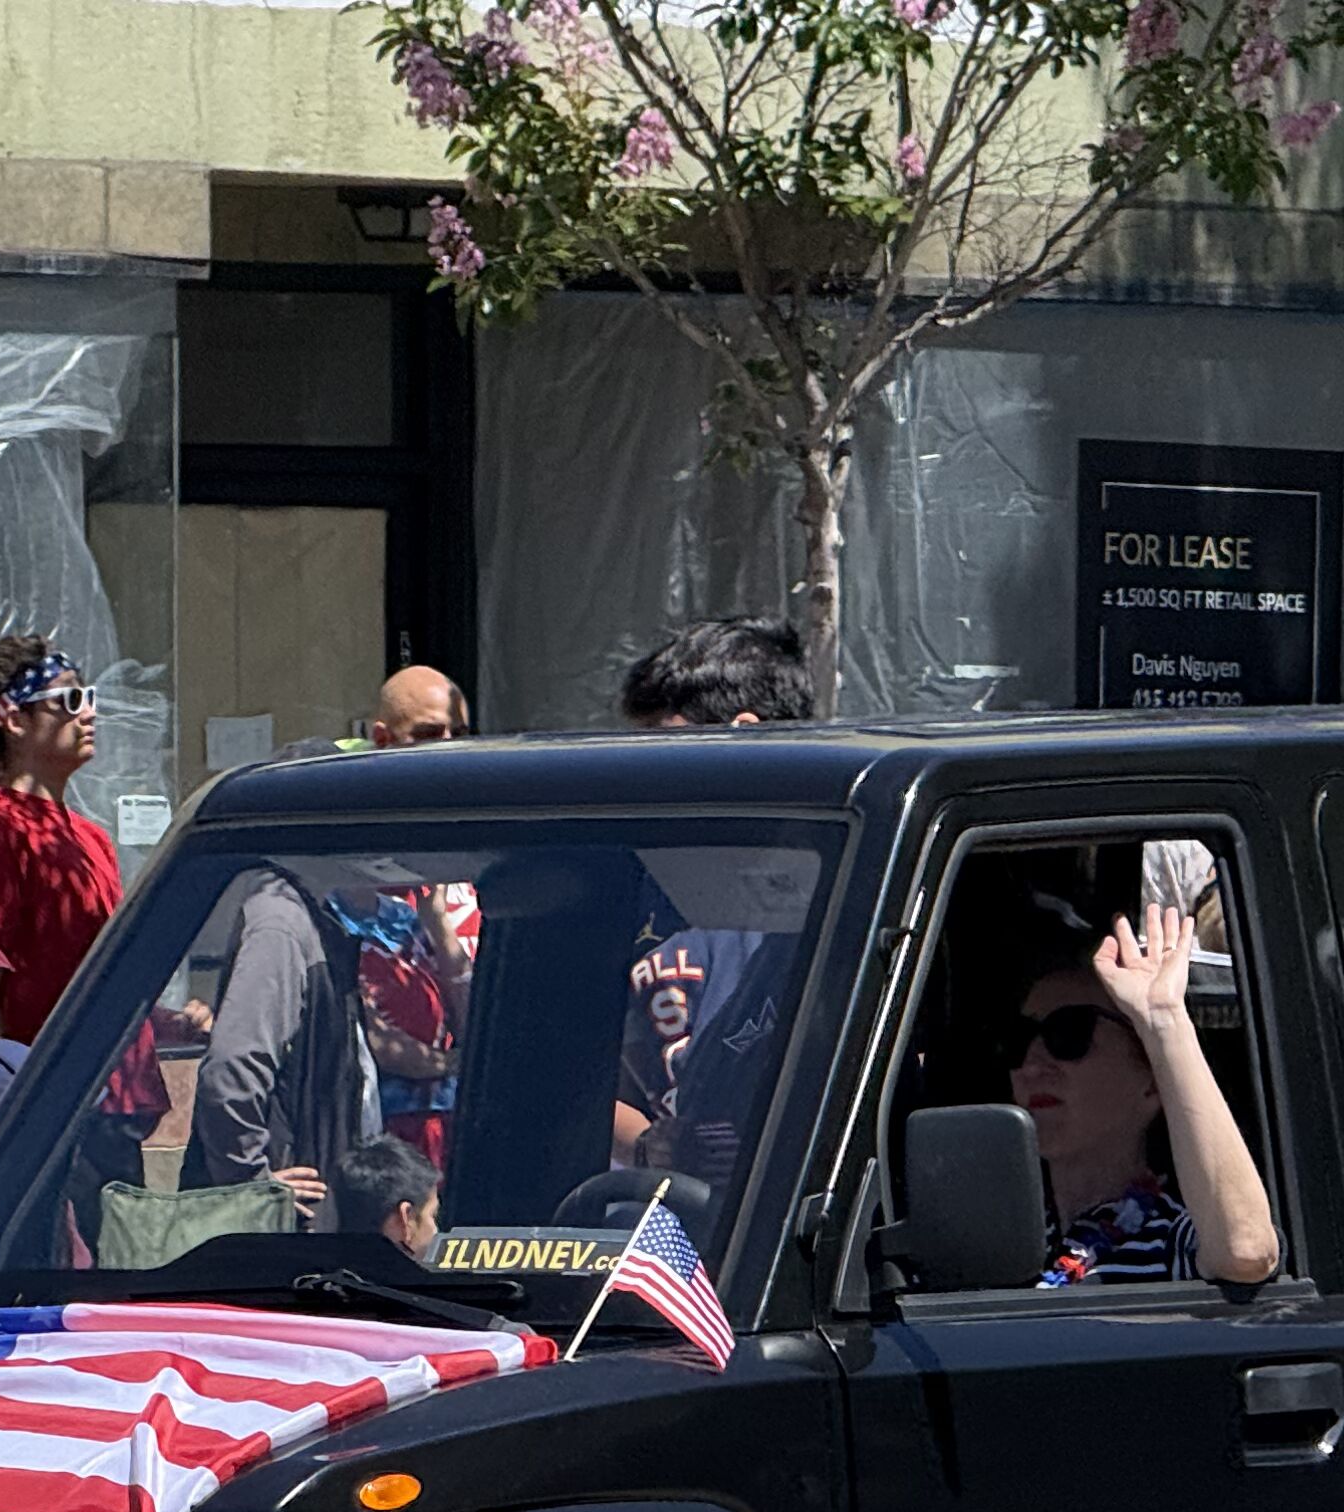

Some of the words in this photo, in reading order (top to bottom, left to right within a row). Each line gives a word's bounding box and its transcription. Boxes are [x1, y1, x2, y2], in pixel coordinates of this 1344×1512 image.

[1104, 531, 1161, 567] FOR
[1168, 535, 1253, 571] LEASE
[1159, 589, 1181, 611] SQ
[1183, 590, 1204, 608] FT
[1205, 590, 1255, 611] RETAIL
[1257, 592, 1306, 613] SPACE
[1132, 653, 1176, 677] Davis
[1179, 655, 1241, 682] Nguyen
